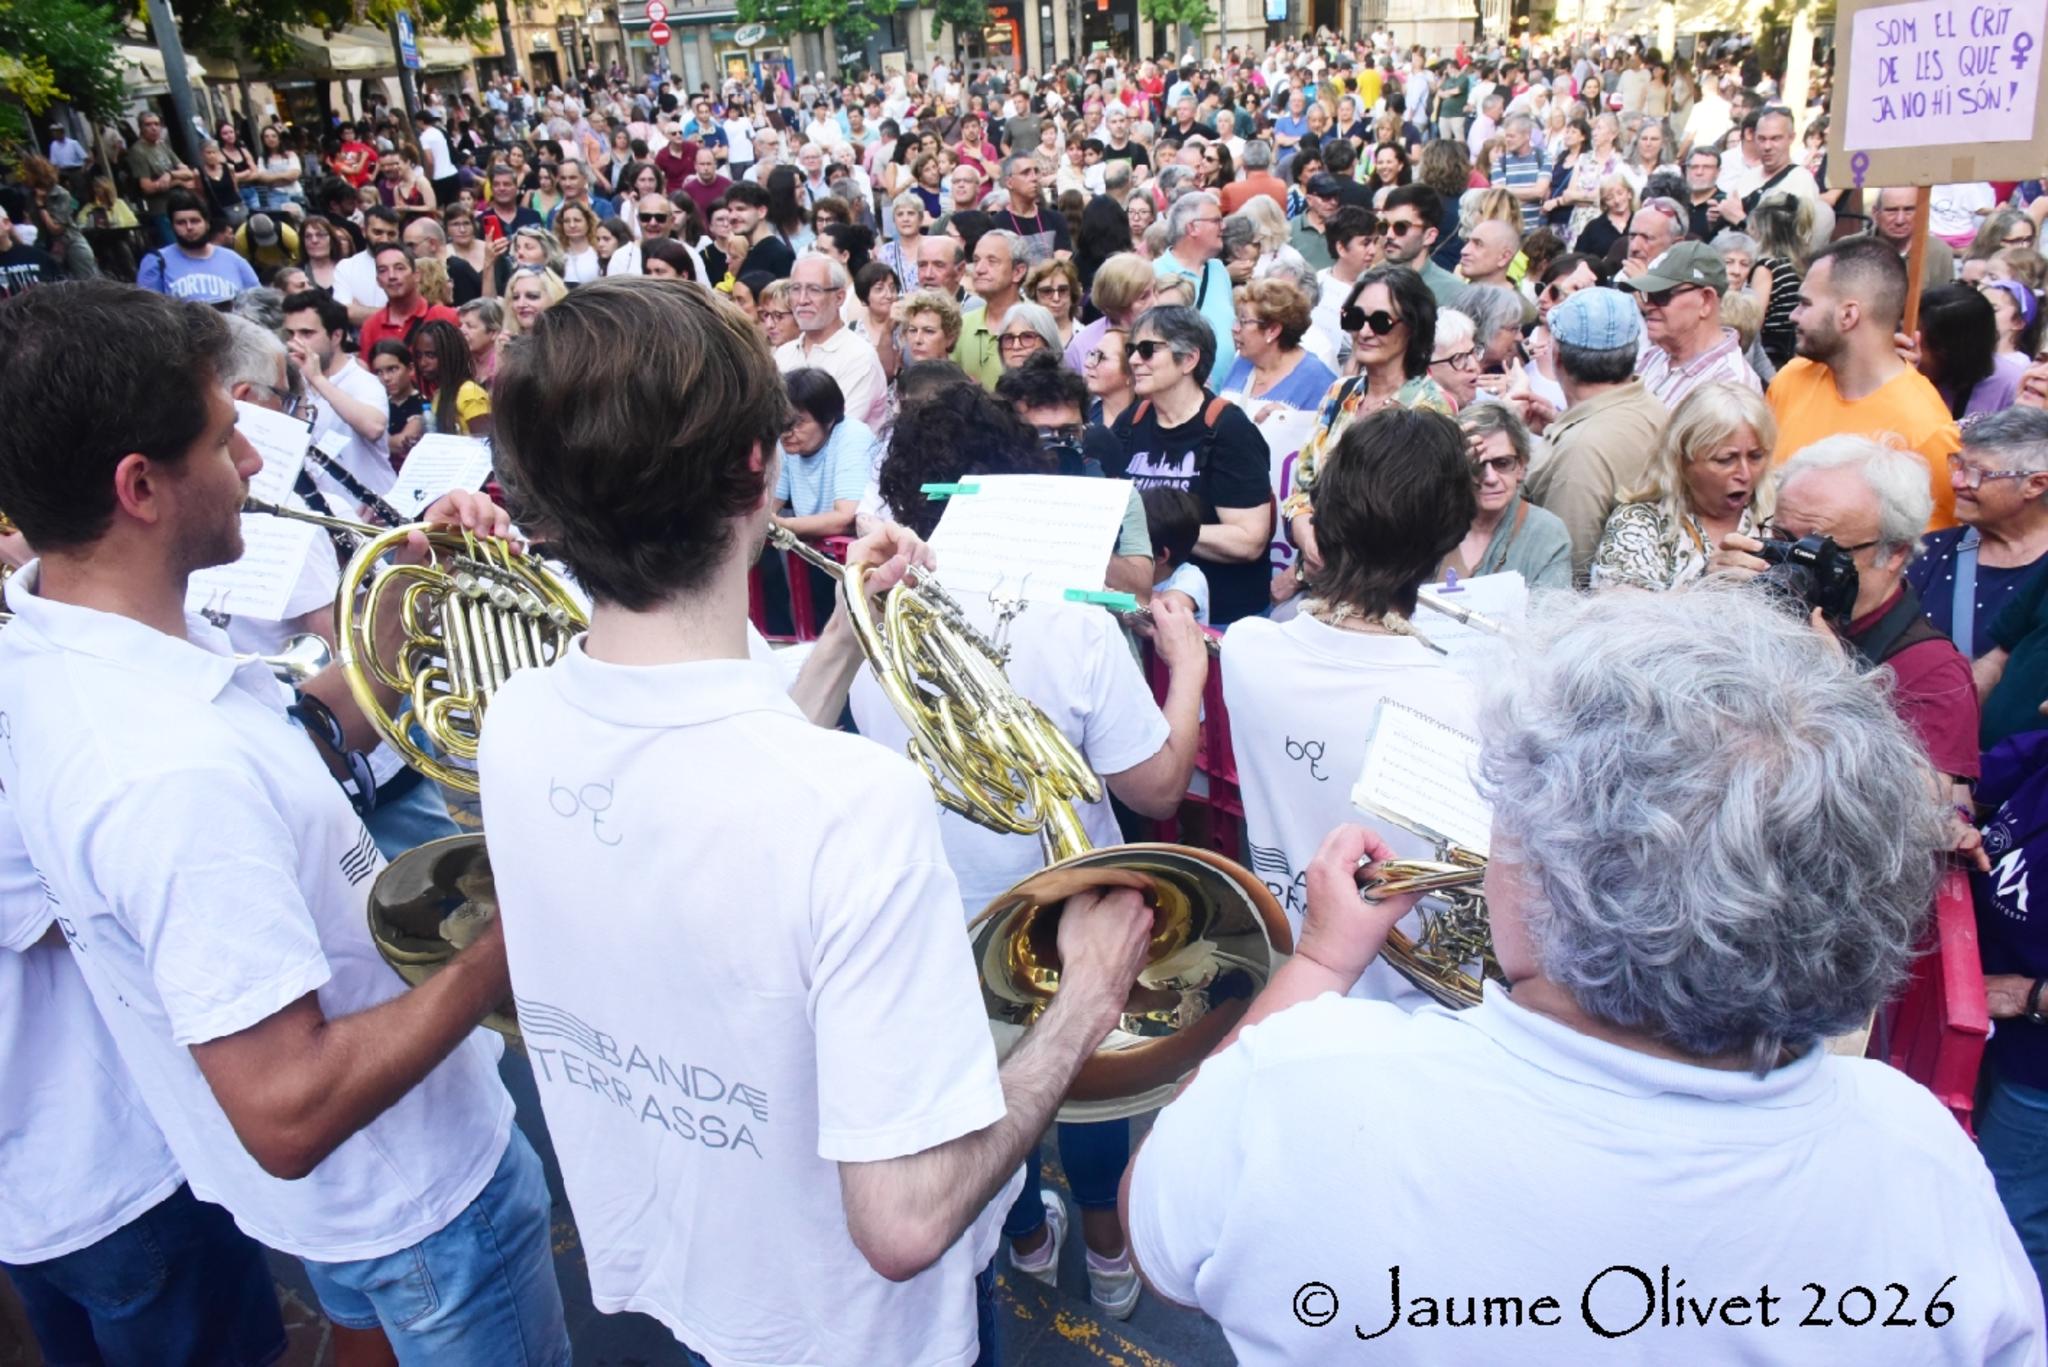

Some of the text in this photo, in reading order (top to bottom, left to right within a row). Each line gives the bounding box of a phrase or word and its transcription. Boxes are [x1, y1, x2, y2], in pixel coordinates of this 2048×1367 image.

[1875, 5, 2013, 47] SOM EL CRIT
[1878, 45, 2001, 88] DE LES QUE
[1871, 95, 1897, 123] JA
[1901, 90, 1927, 120] NO
[527, 1045, 764, 1160] TERRASSA
